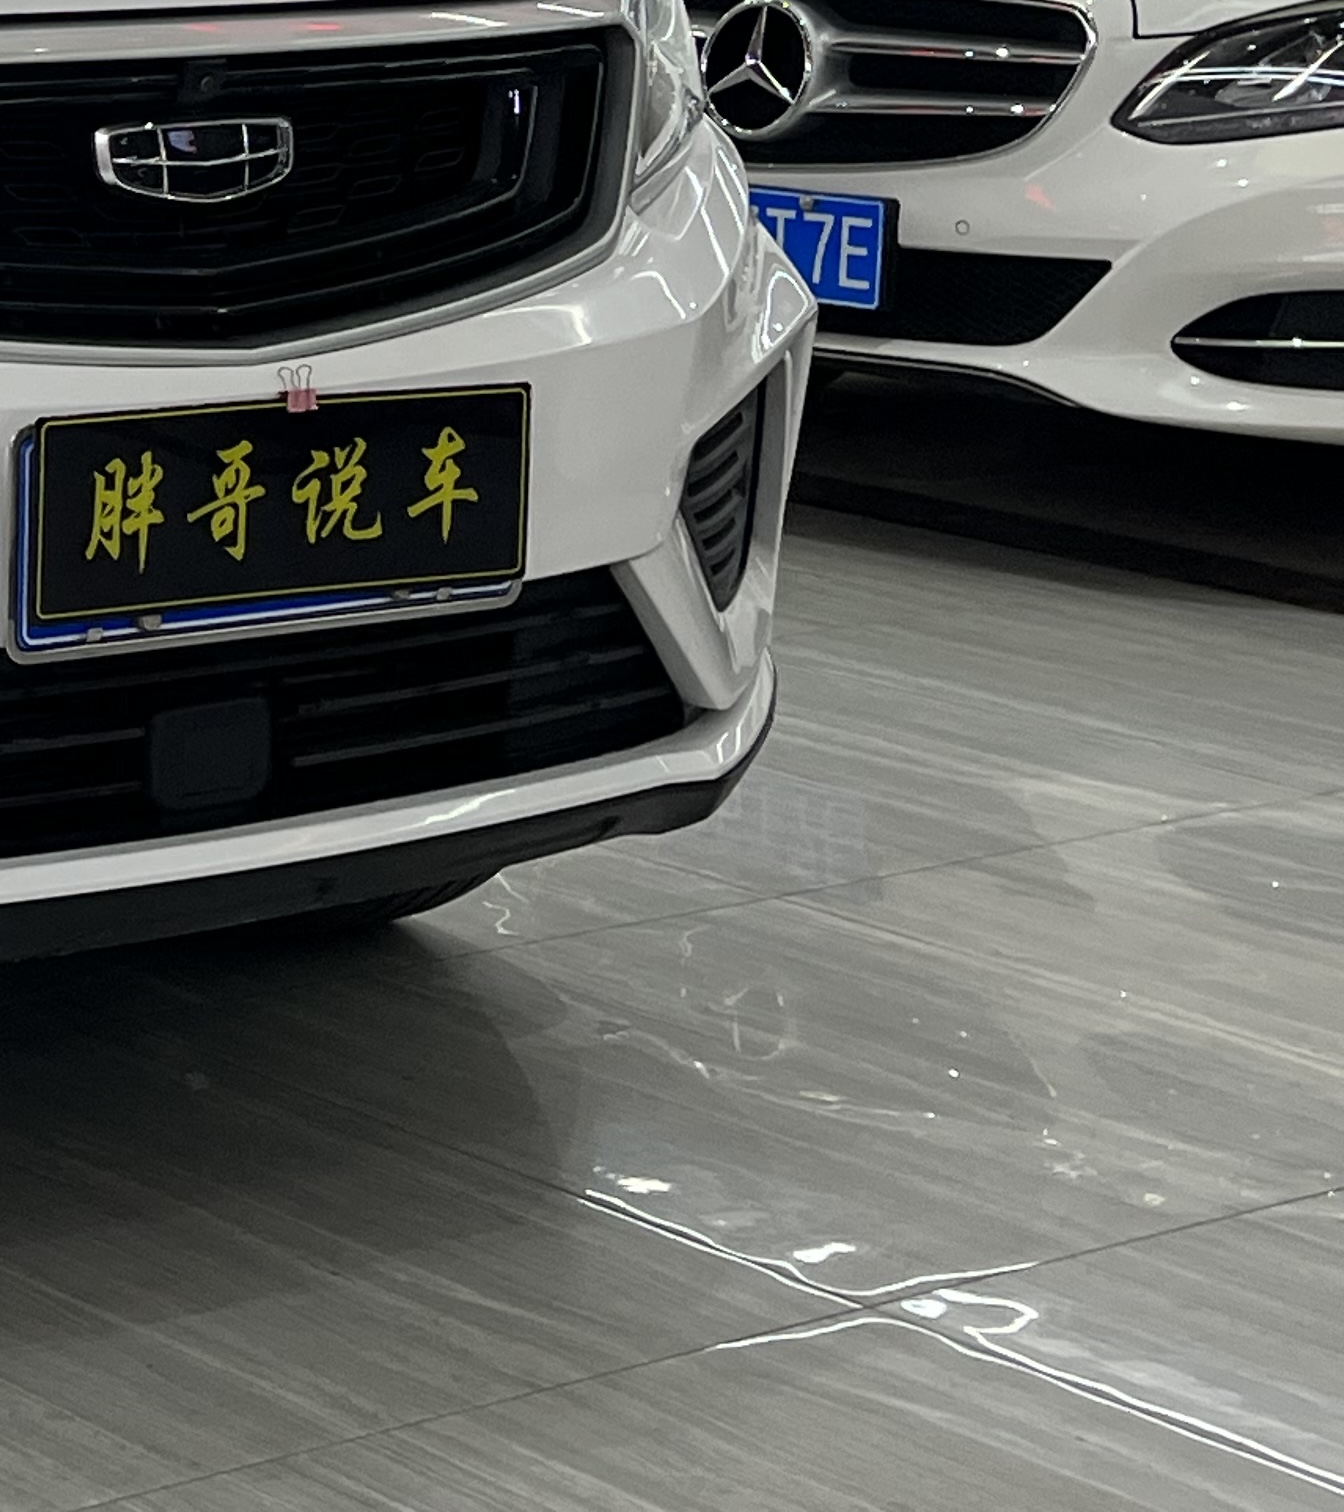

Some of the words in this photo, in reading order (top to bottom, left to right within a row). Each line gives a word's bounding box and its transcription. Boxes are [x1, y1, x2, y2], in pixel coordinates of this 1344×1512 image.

[749, 204, 873, 291] T7E
[85, 426, 480, 576] 胖哥说车
